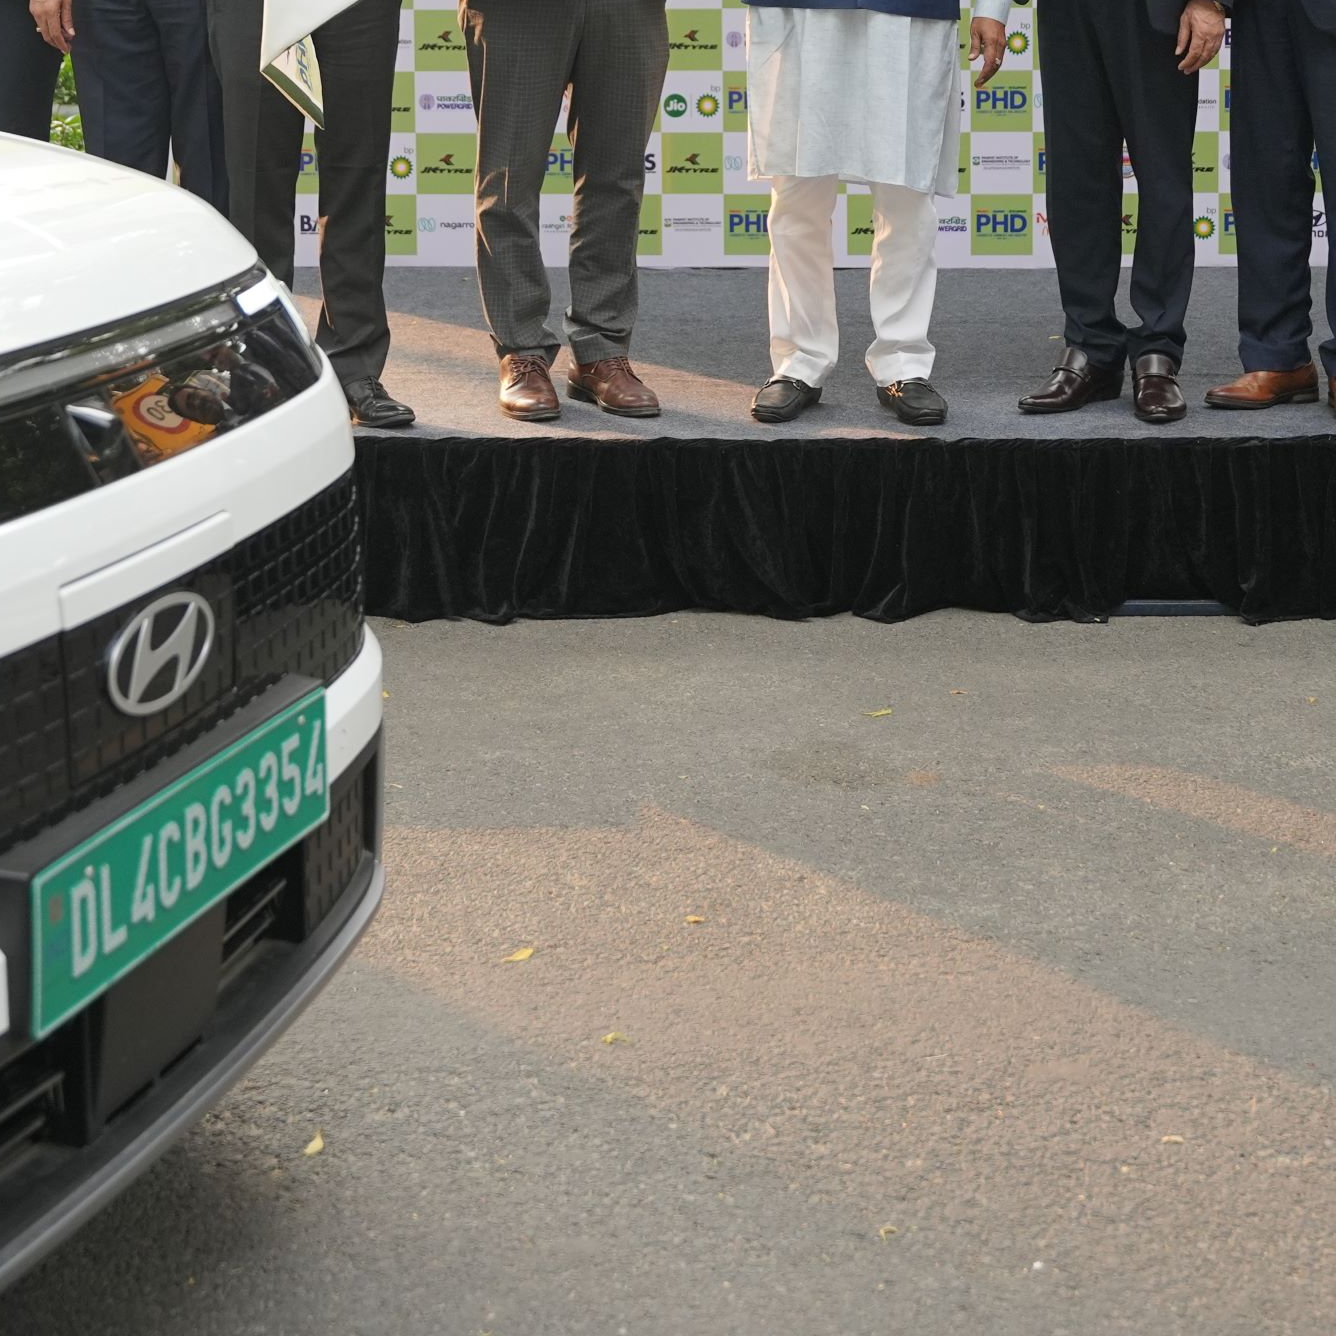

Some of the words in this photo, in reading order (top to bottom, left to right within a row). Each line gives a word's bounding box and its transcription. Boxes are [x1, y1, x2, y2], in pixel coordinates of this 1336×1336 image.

[1020, 22, 1031, 30] bp
[711, 85, 721, 93] bp
[976, 90, 1028, 110] PHD
[437, 102, 473, 110] POWERGRID
[666, 99, 686, 112] Jio
[403, 147, 414, 155] bp
[1206, 207, 1217, 215] bp
[440, 221, 475, 230] nagarro
[976, 214, 1028, 233] PHD
[70, 718, 324, 978] DL4CBG3354
